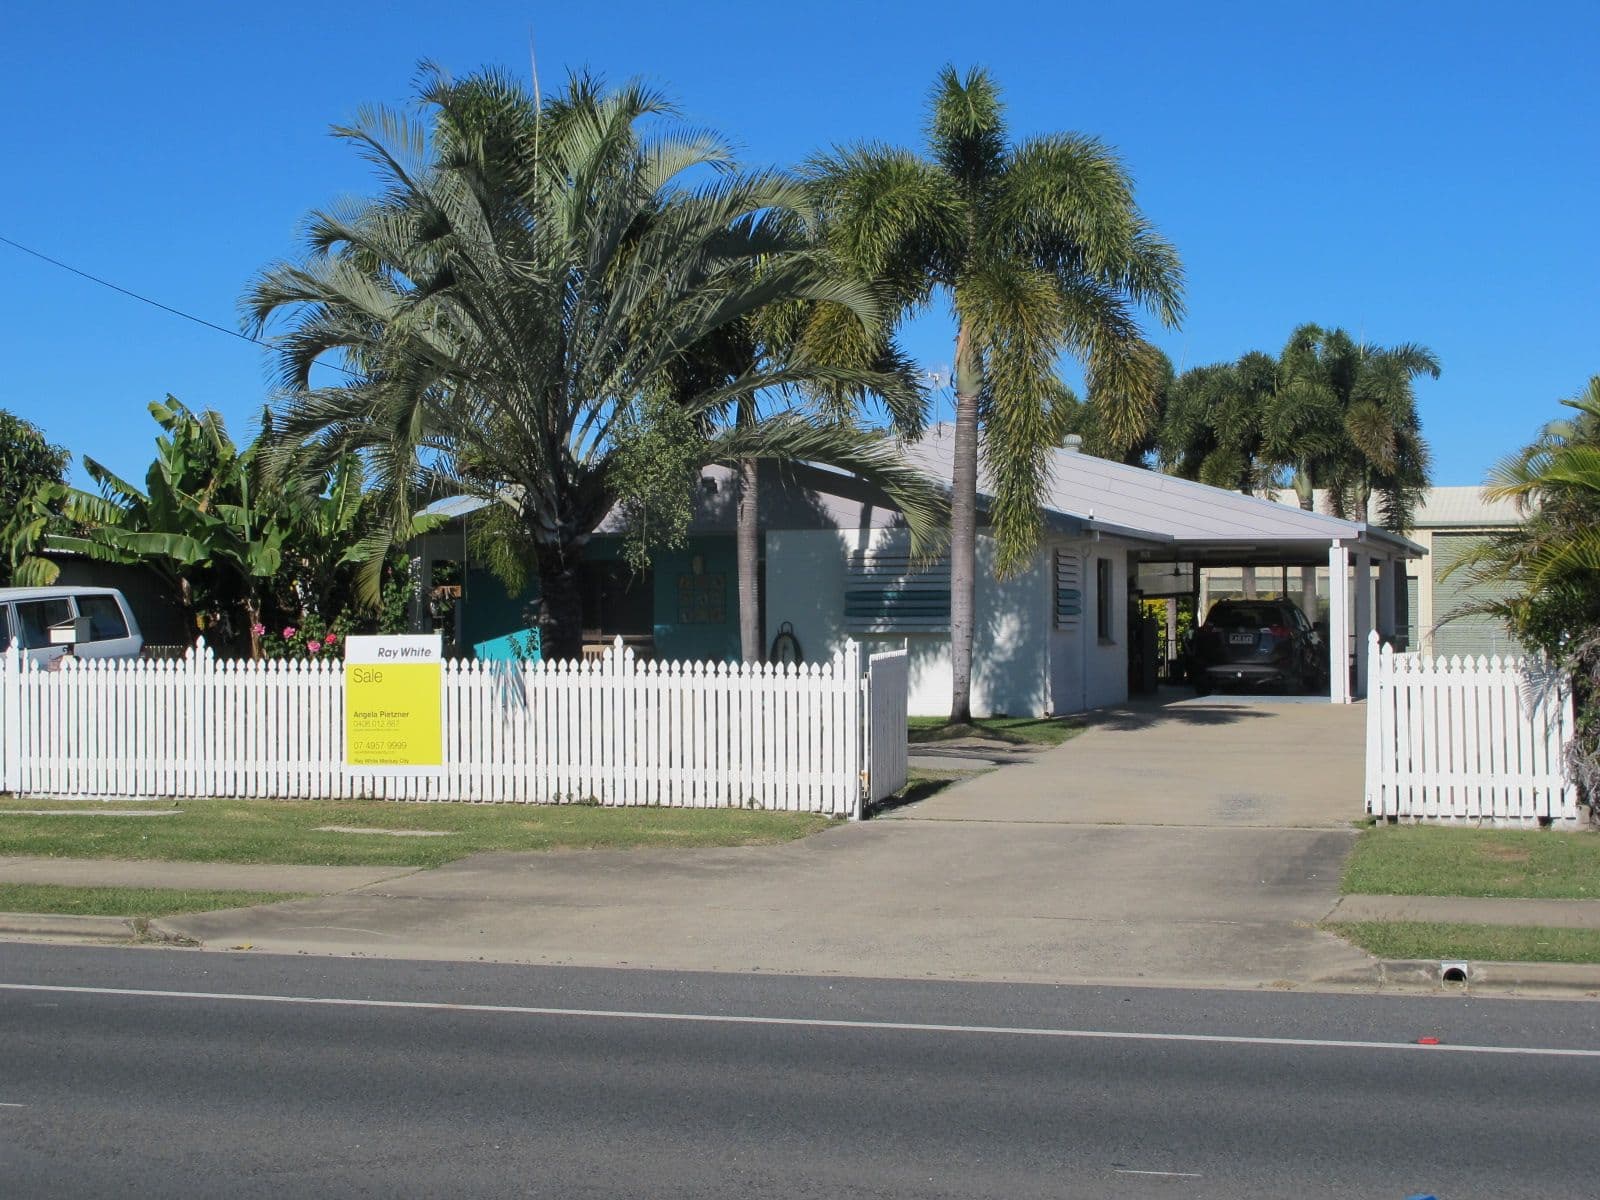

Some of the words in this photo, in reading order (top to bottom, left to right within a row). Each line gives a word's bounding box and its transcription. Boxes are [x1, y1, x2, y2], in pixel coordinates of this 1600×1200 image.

[378, 648, 398, 659] Ray
[401, 648, 431, 657] White
[353, 668, 383, 683] Sale
[353, 711, 378, 719] Angela
[353, 741, 363, 750] 07
